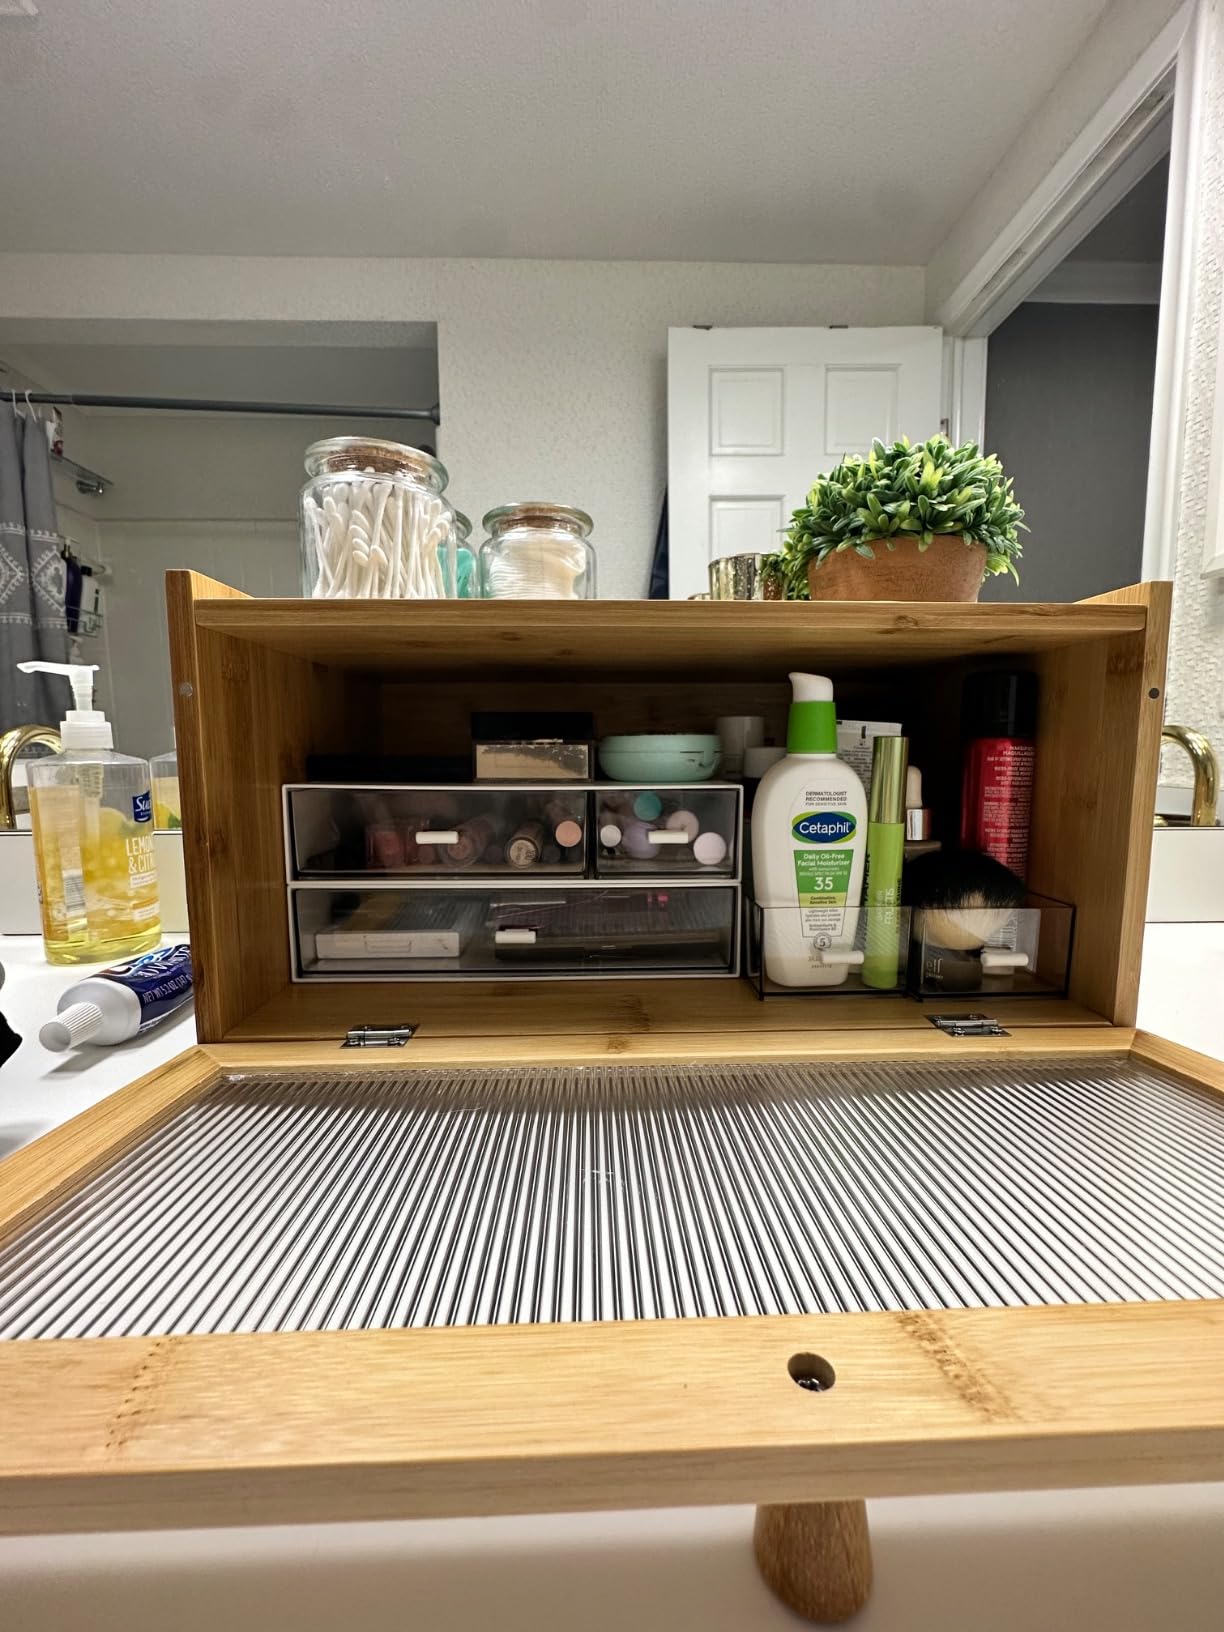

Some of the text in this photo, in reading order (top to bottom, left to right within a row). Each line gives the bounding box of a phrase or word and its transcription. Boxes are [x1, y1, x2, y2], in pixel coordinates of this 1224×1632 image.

[799, 821, 851, 836] Cetaphil
[128, 857, 137, 874] &
[813, 876, 834, 891] 35
[142, 990, 155, 1004] NET
